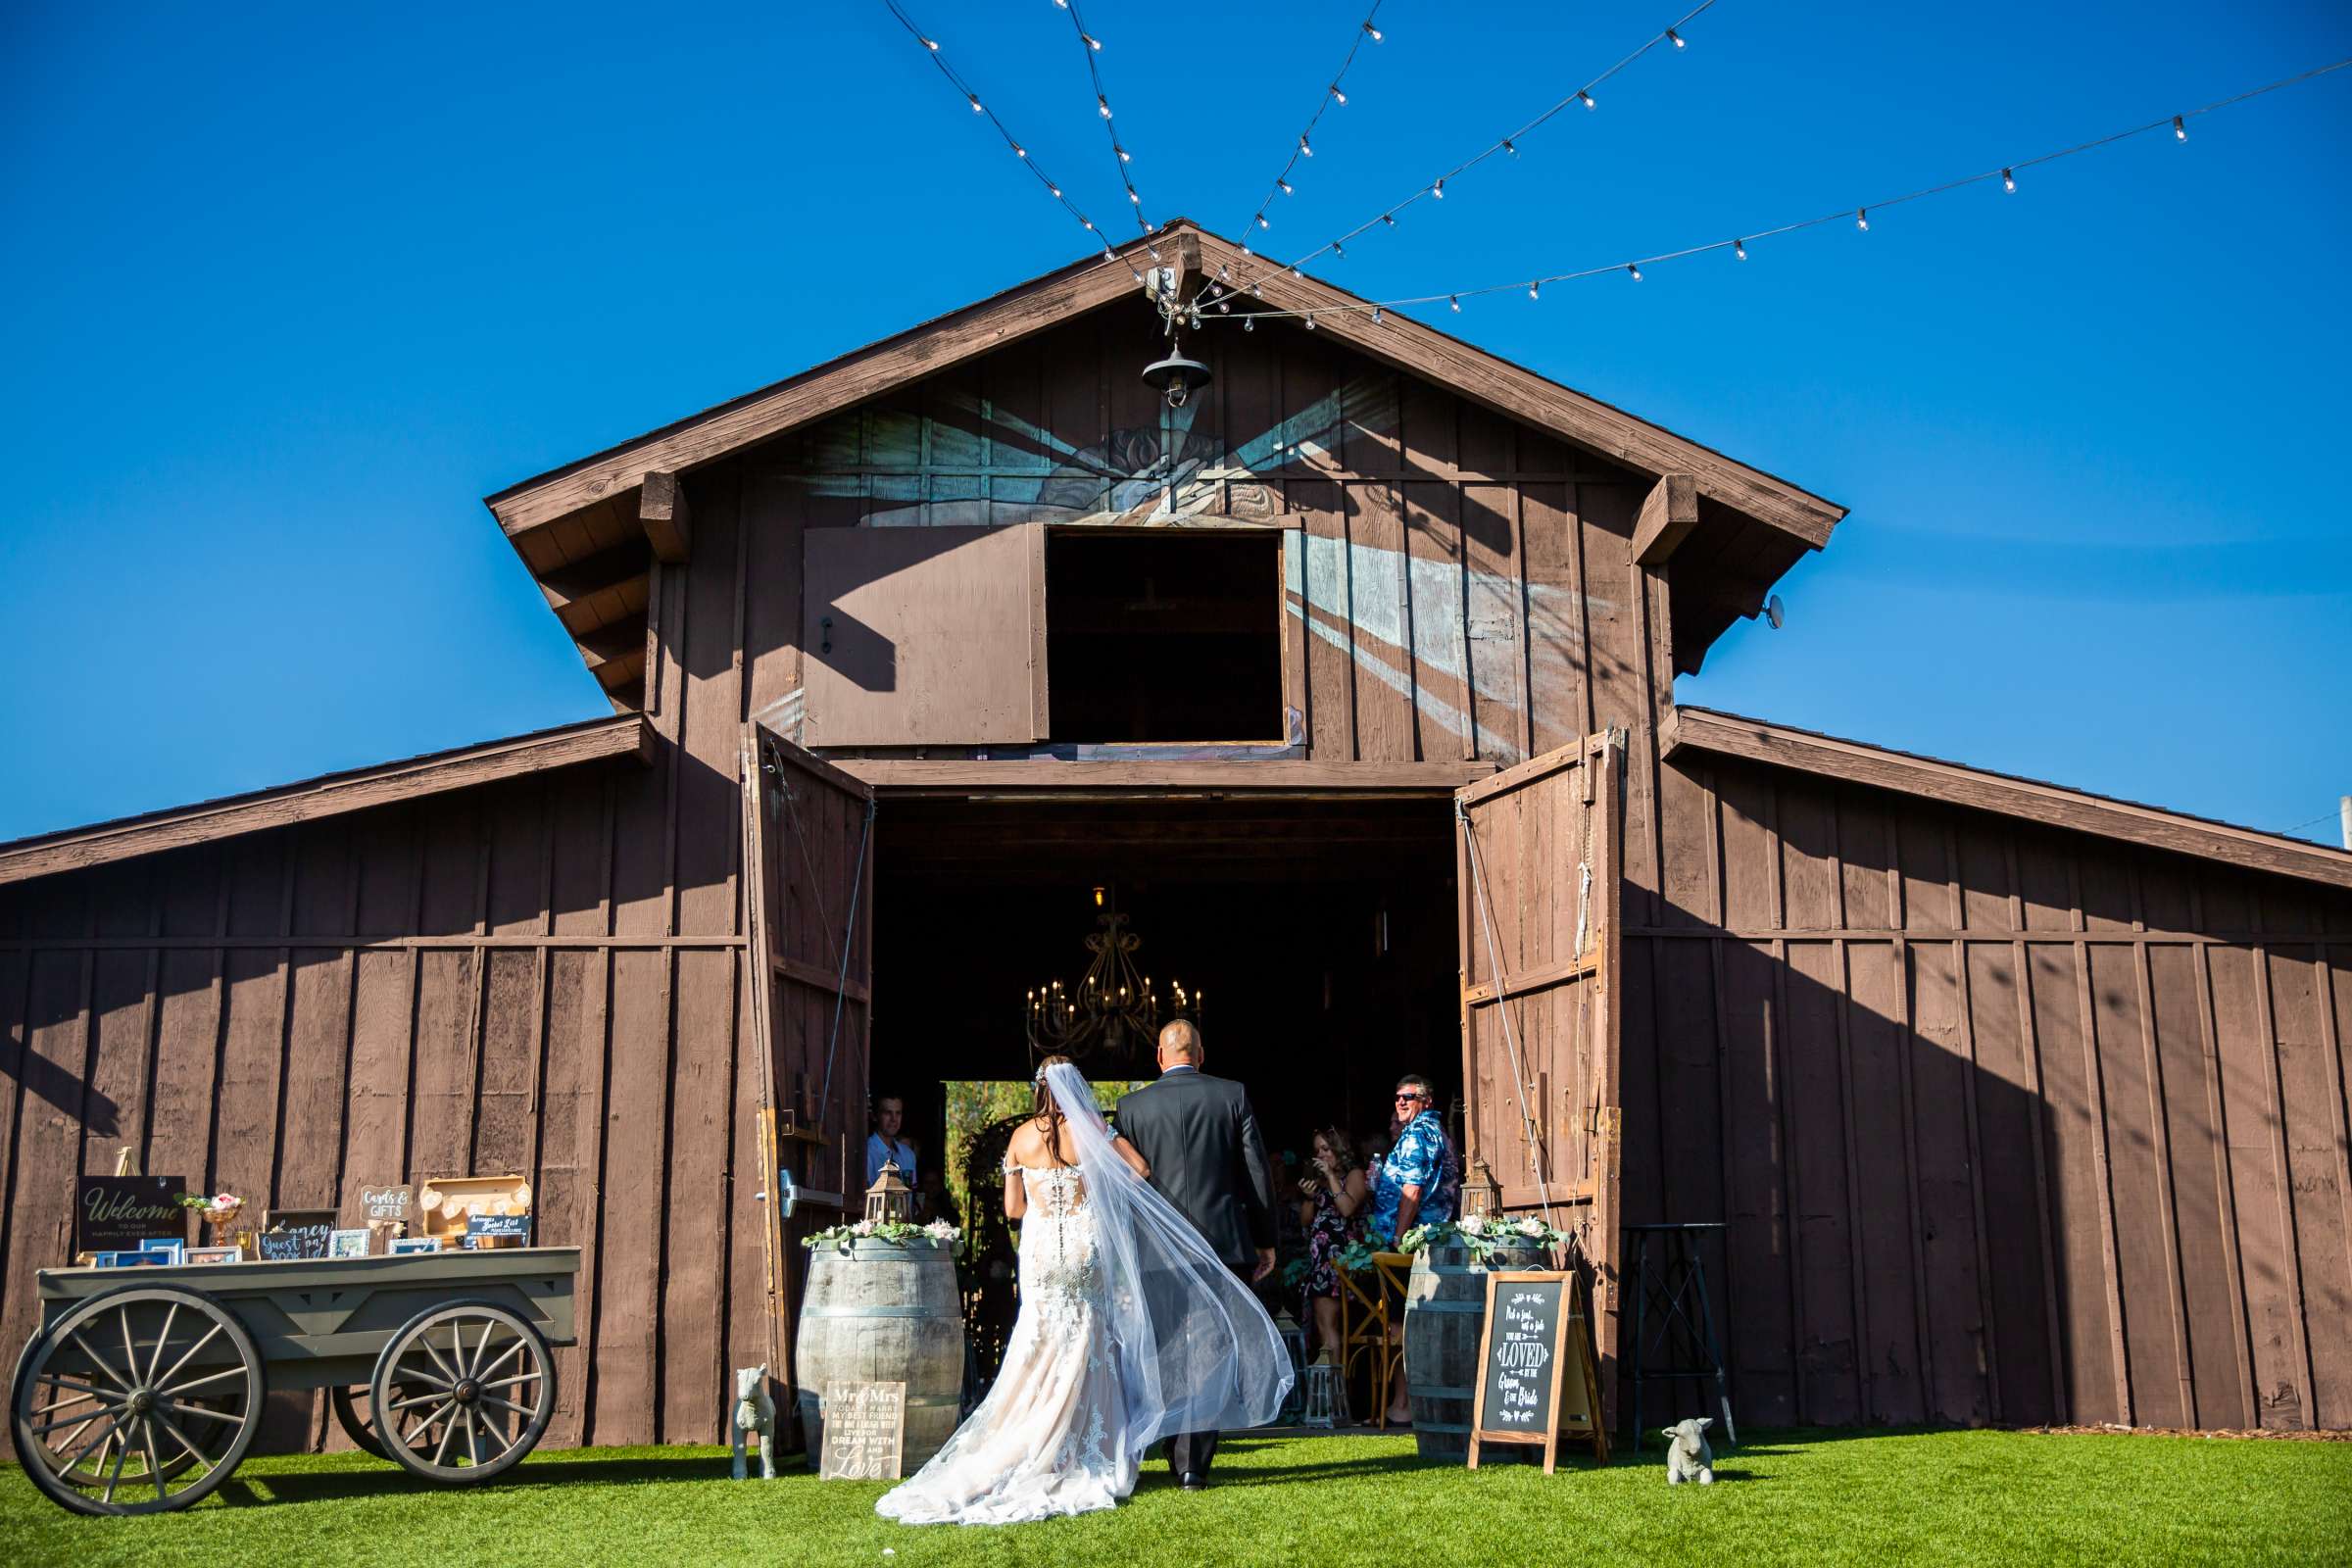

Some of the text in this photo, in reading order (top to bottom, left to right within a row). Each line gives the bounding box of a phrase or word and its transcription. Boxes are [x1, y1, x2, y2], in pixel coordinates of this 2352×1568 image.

[85, 1187, 178, 1222] Welcome
[364, 1190, 395, 1204] Cards
[398, 1191, 408, 1205] &
[370, 1204, 402, 1217] GIFTS
[262, 1234, 301, 1254] Guest
[1505, 1332, 1514, 1341] YOU
[1500, 1342, 1544, 1367] LOVED
[1497, 1371, 1520, 1391] Groom
[1524, 1368, 1530, 1377] BY
[832, 1389, 857, 1402] Mr
[870, 1389, 899, 1402] Mrs
[1518, 1386, 1538, 1407] Bride
[830, 1446, 901, 1479] Love
